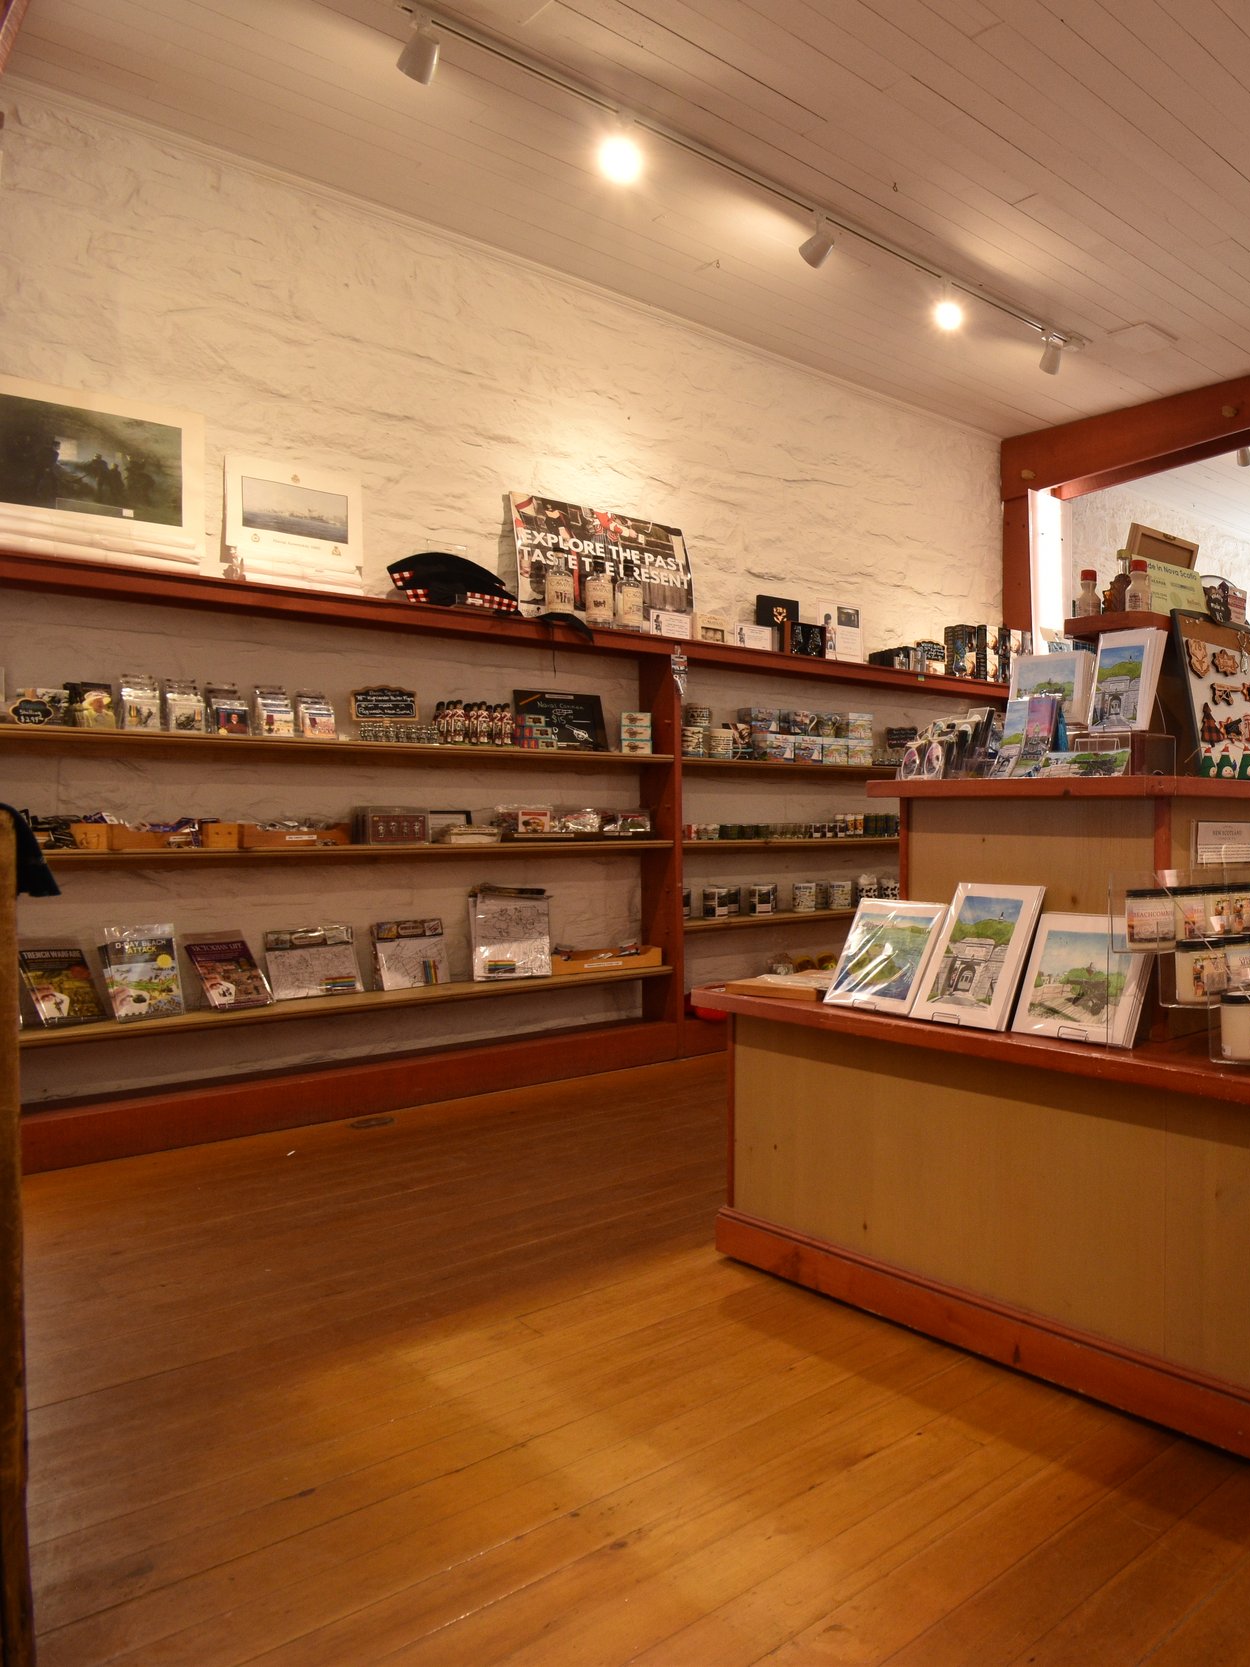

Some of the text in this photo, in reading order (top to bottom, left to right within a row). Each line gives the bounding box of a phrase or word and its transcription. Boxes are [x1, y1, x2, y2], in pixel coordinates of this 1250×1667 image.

[522, 530, 685, 574] EXPLORE THE PAST
[581, 557, 615, 577] TE
[1164, 566, 1179, 576] Nova
[1179, 570, 1197, 581] Scotia
[23, 949, 82, 960] TRENCH WARFARE
[127, 946, 156, 954] ATTACK
